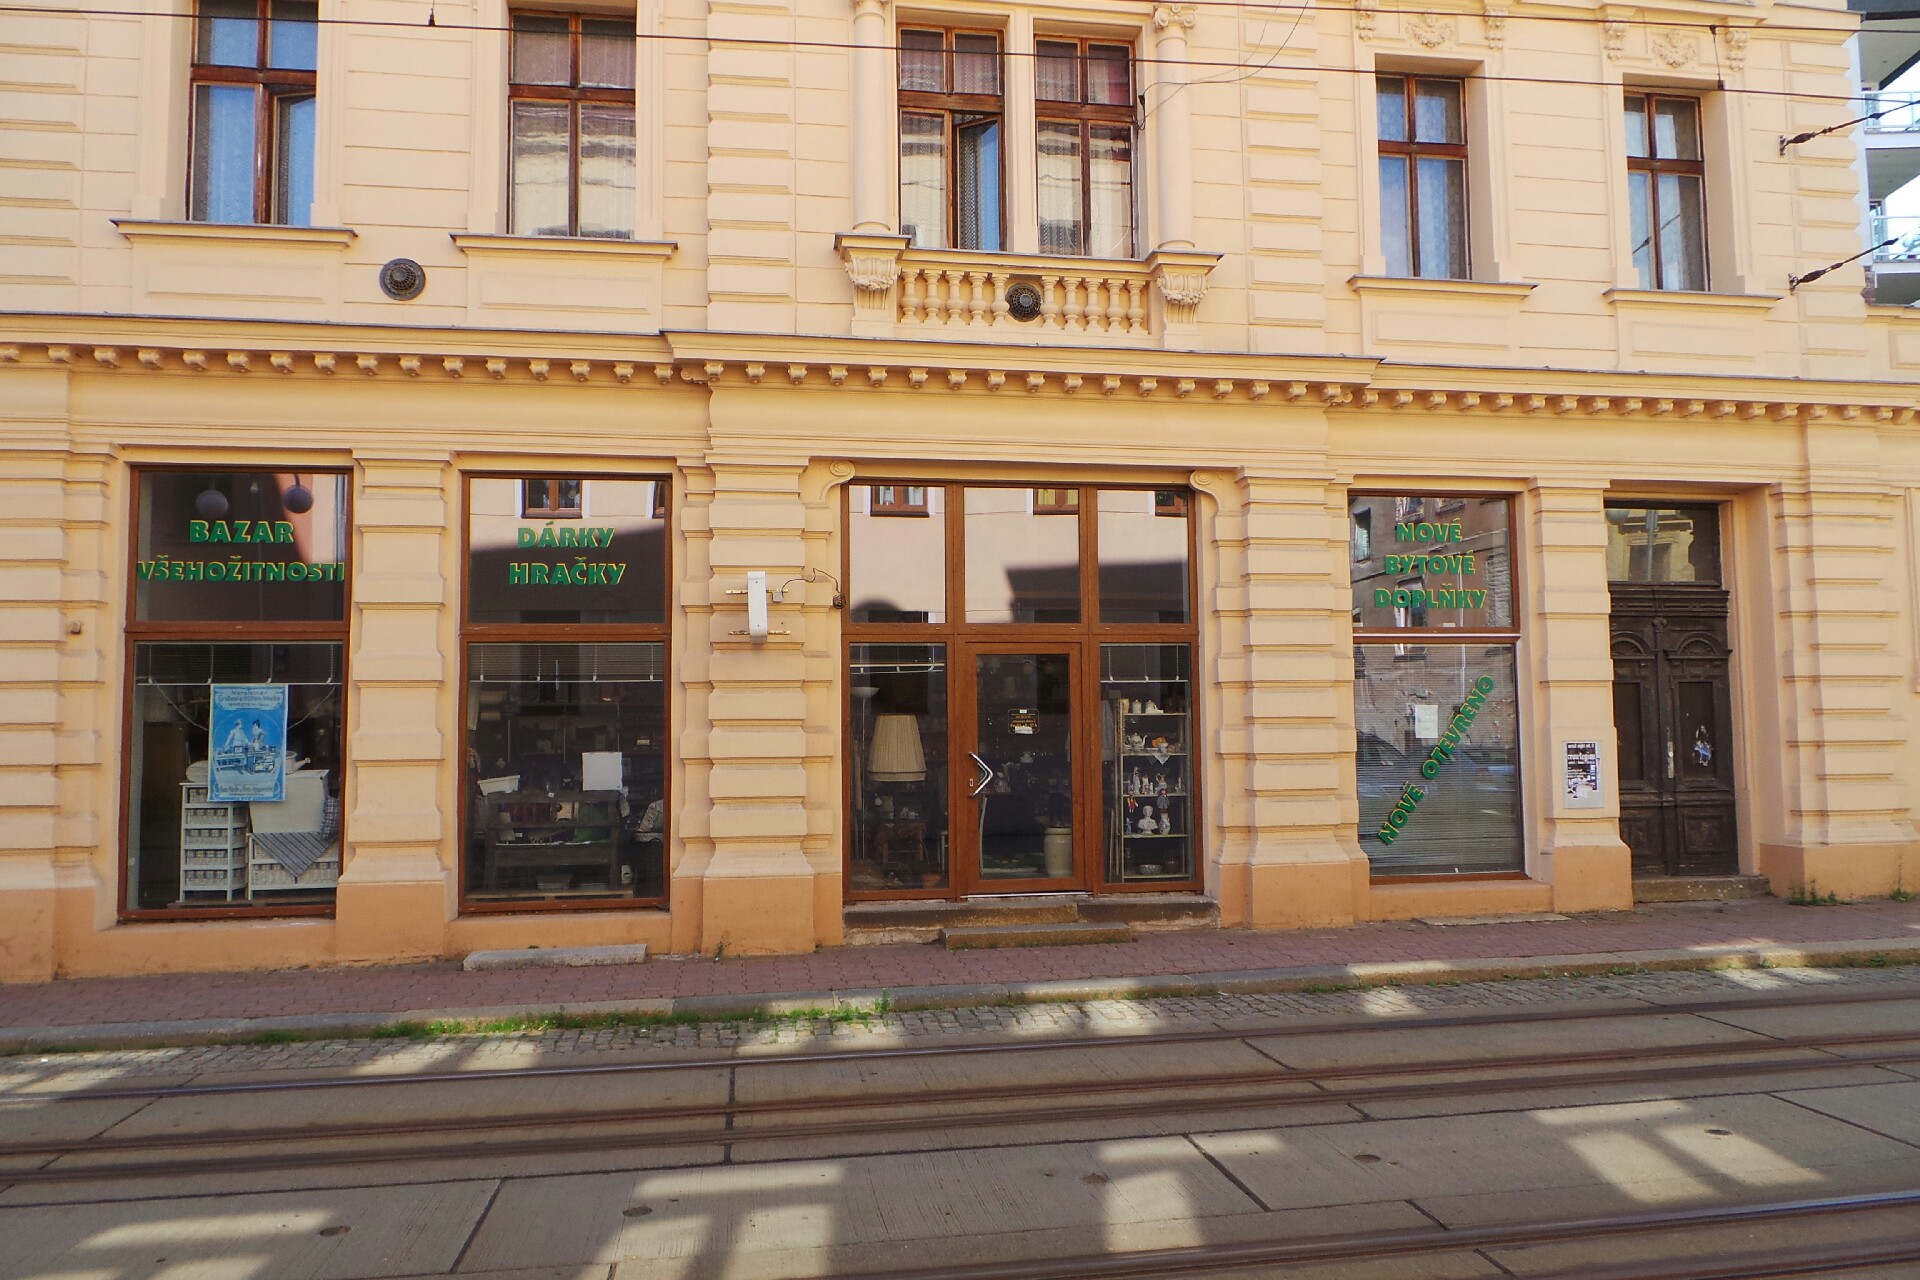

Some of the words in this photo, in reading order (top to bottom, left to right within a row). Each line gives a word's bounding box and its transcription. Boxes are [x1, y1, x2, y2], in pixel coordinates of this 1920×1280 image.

[188, 519, 295, 544] BAZAR
[517, 521, 616, 549] DÁRKY
[1396, 517, 1463, 543] NOVÉ
[136, 554, 345, 582] VŠEHOŽITNOSTI
[508, 556, 626, 585] HRAČKY
[1385, 549, 1476, 576] BYTOVÉ
[1375, 583, 1487, 609] DOPLŇKY
[1420, 675, 1495, 780] OTEVŘENO
